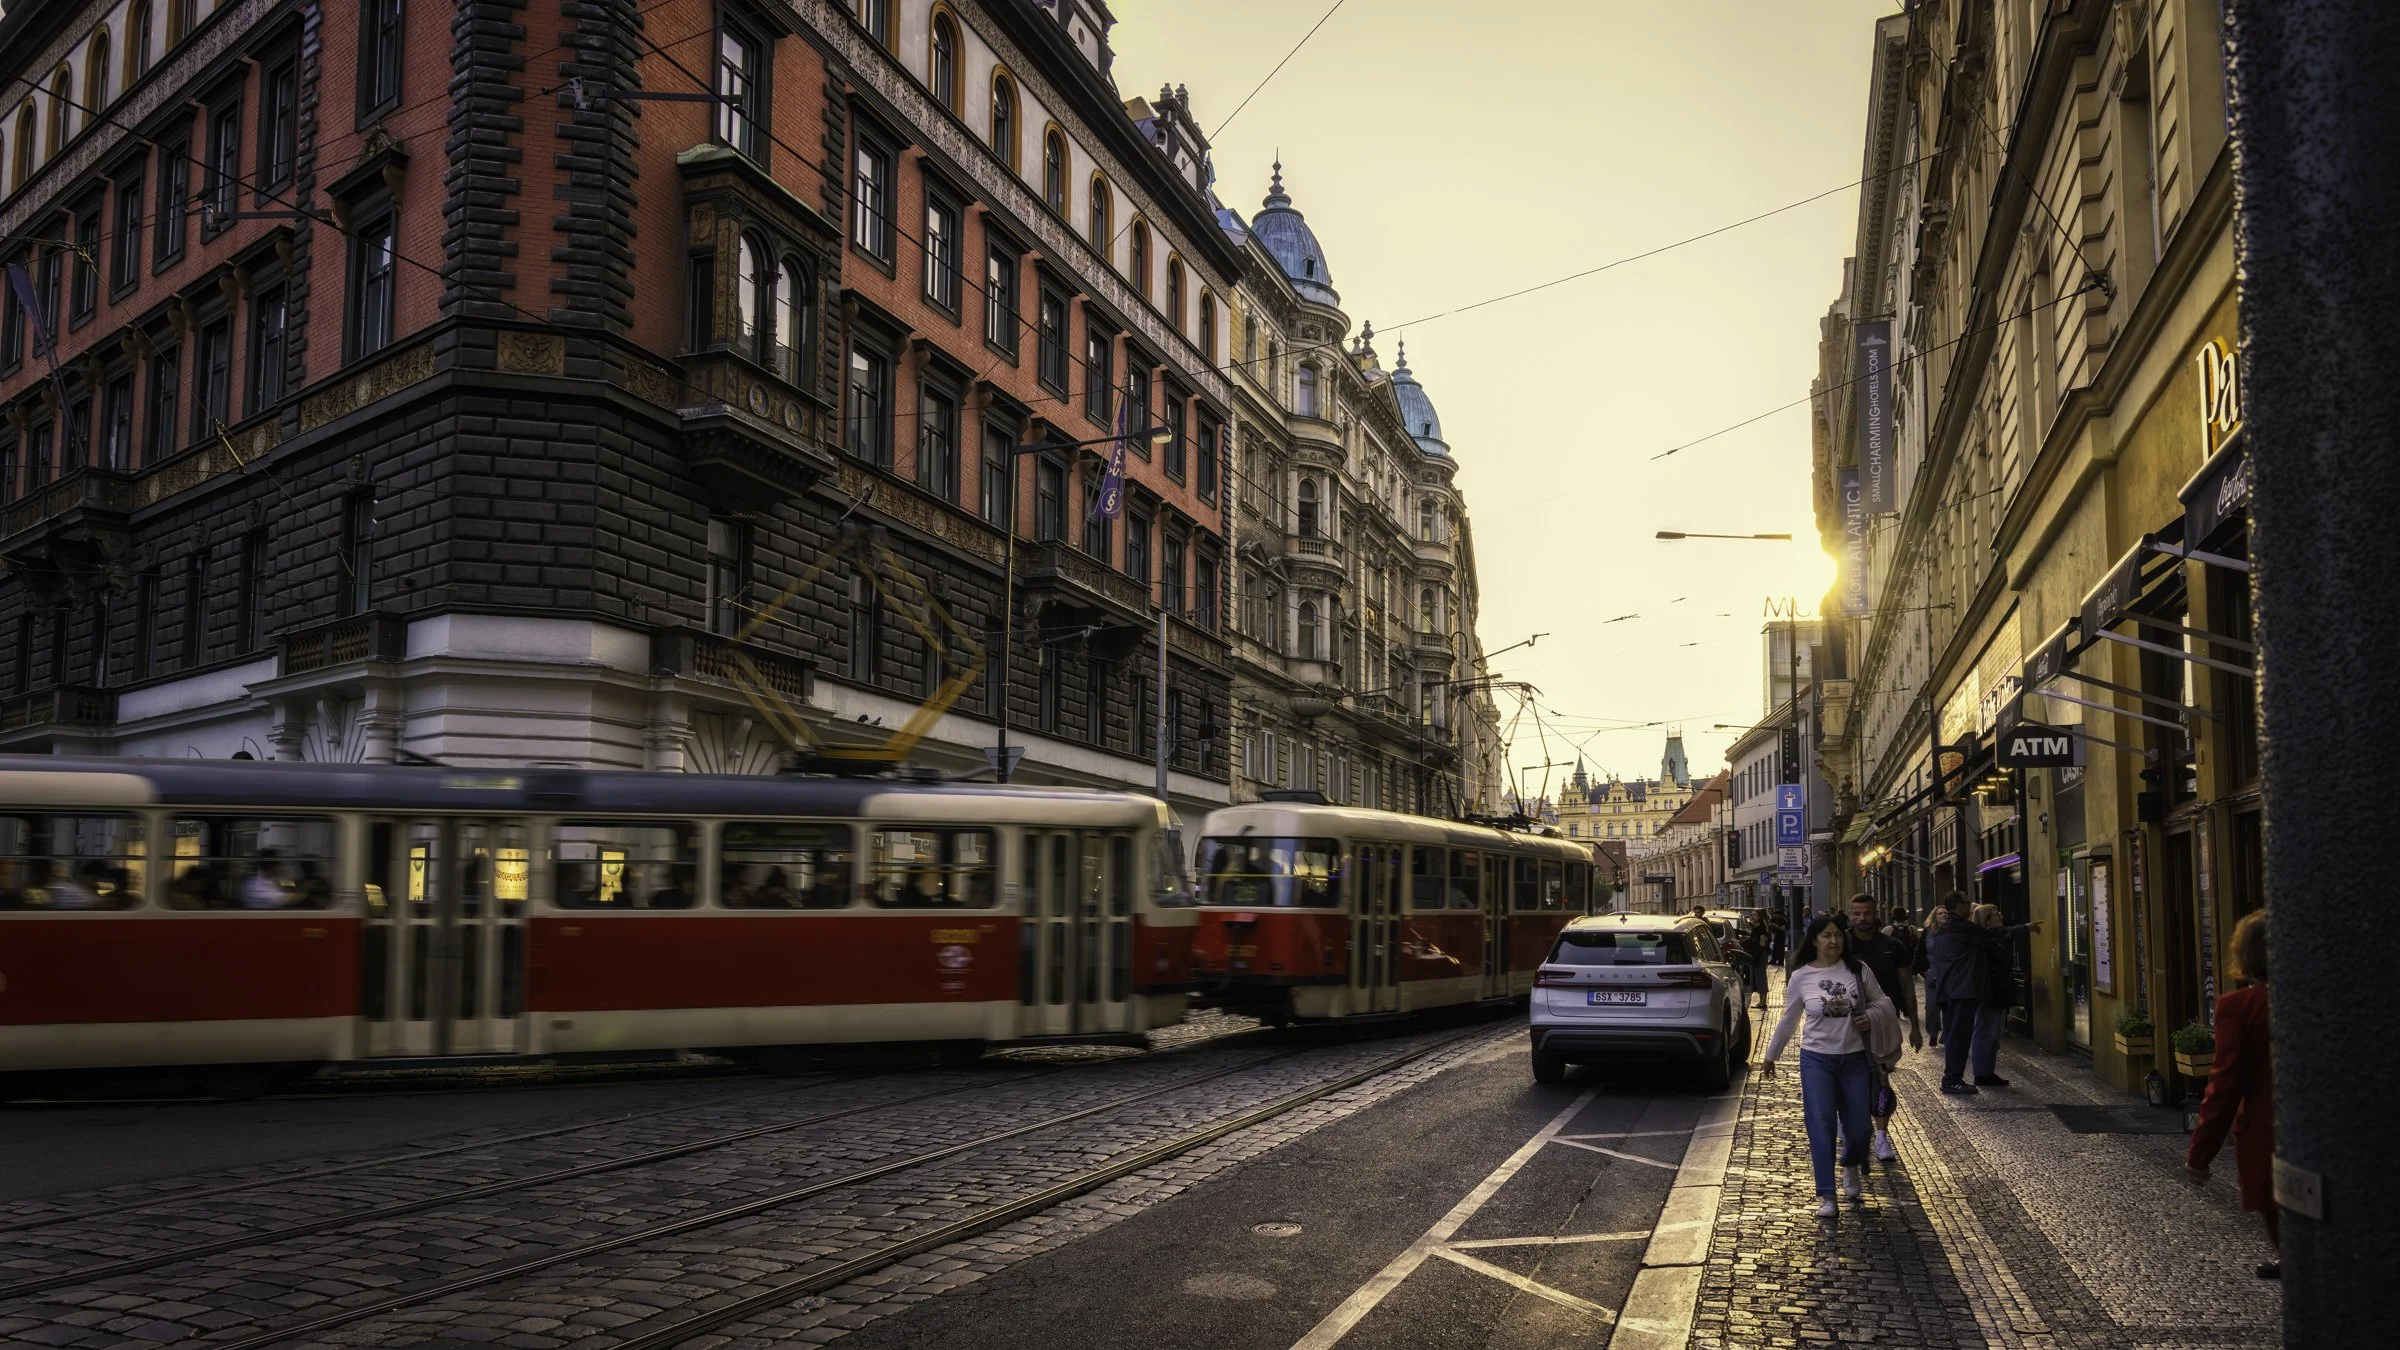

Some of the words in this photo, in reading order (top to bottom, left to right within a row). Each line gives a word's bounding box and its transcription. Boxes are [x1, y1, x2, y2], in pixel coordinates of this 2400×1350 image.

[1869, 349, 1881, 503] SMALLCHARMINGHOTELS.COM
[1846, 490, 1862, 561] ATLANTIC
[1851, 565, 1862, 601] HOTEL
[2010, 737, 2068, 756] ATM
[1783, 815, 1797, 834] P
[1595, 992, 1613, 1002] 6SX
[1619, 992, 1642, 1002] 3785
